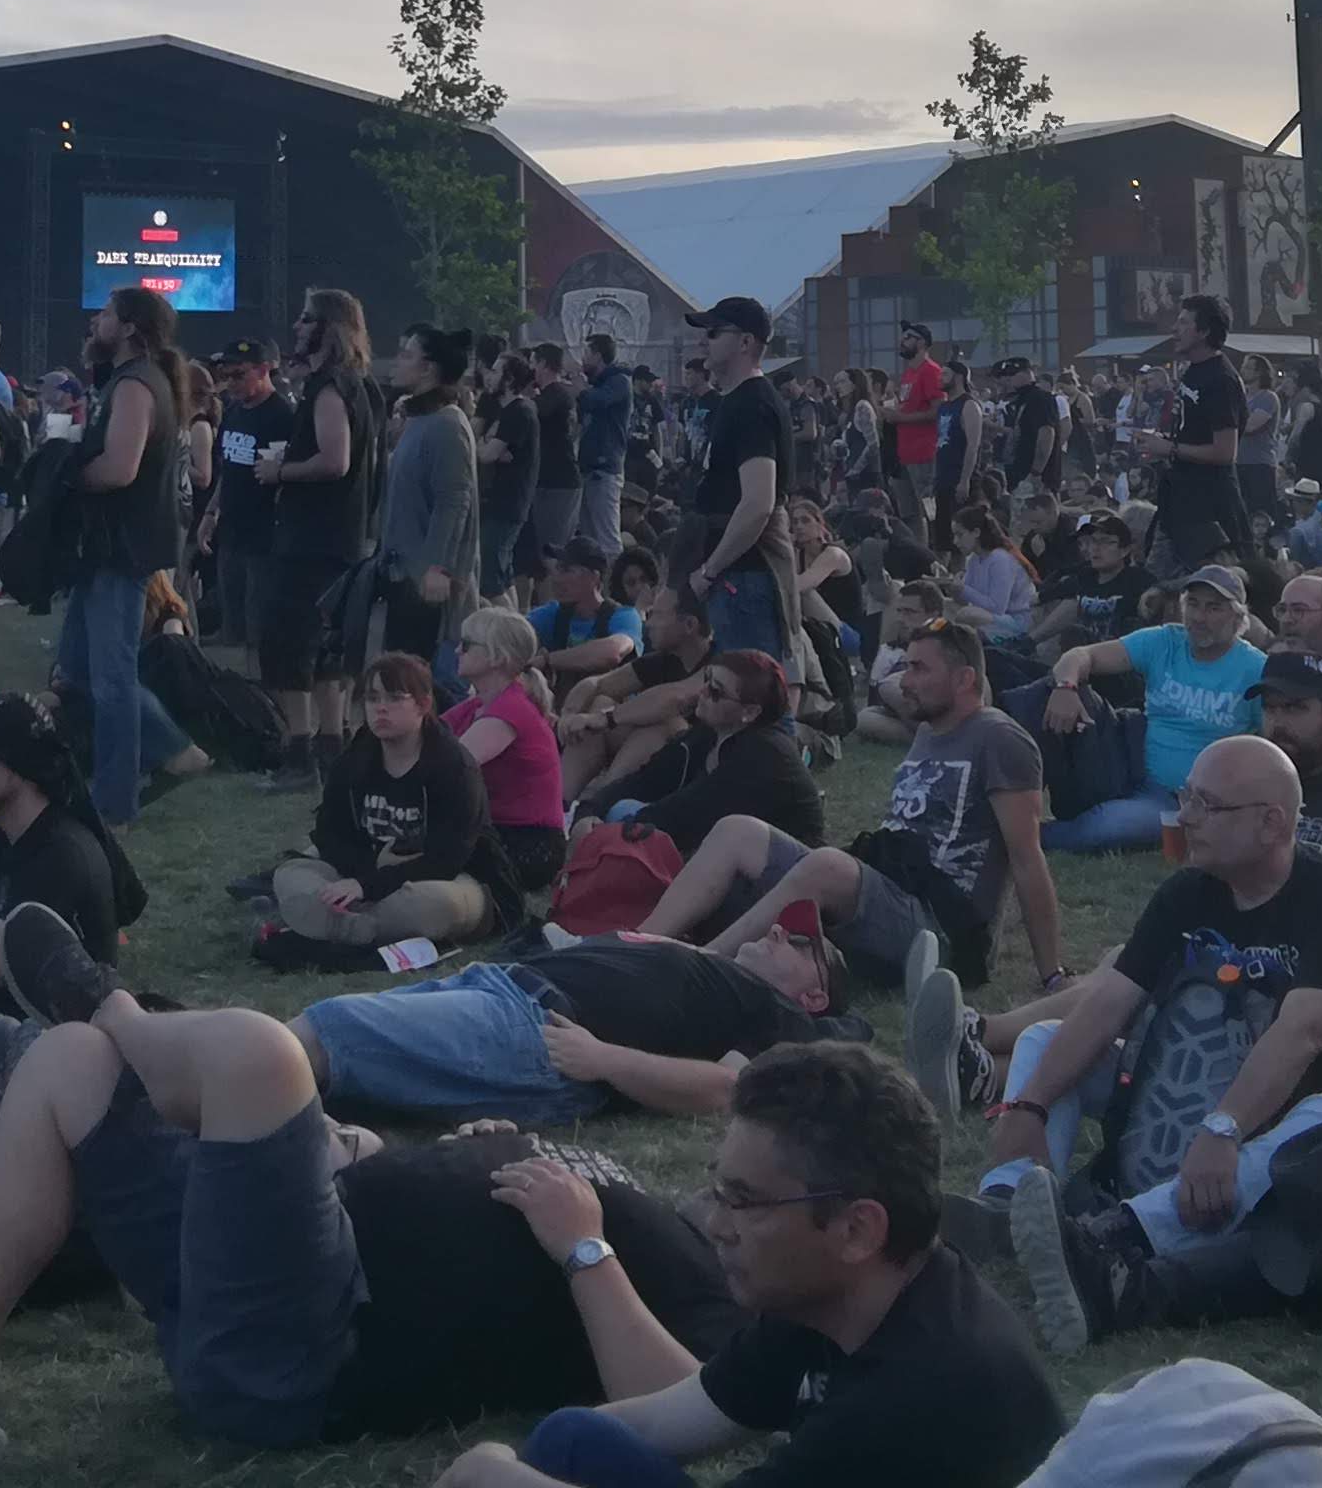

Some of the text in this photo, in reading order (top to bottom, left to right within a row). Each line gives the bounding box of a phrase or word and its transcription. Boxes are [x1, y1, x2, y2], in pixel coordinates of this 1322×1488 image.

[96, 251, 222, 268] DARK TRANQUILLITY
[1161, 672, 1241, 714] TOMMY
